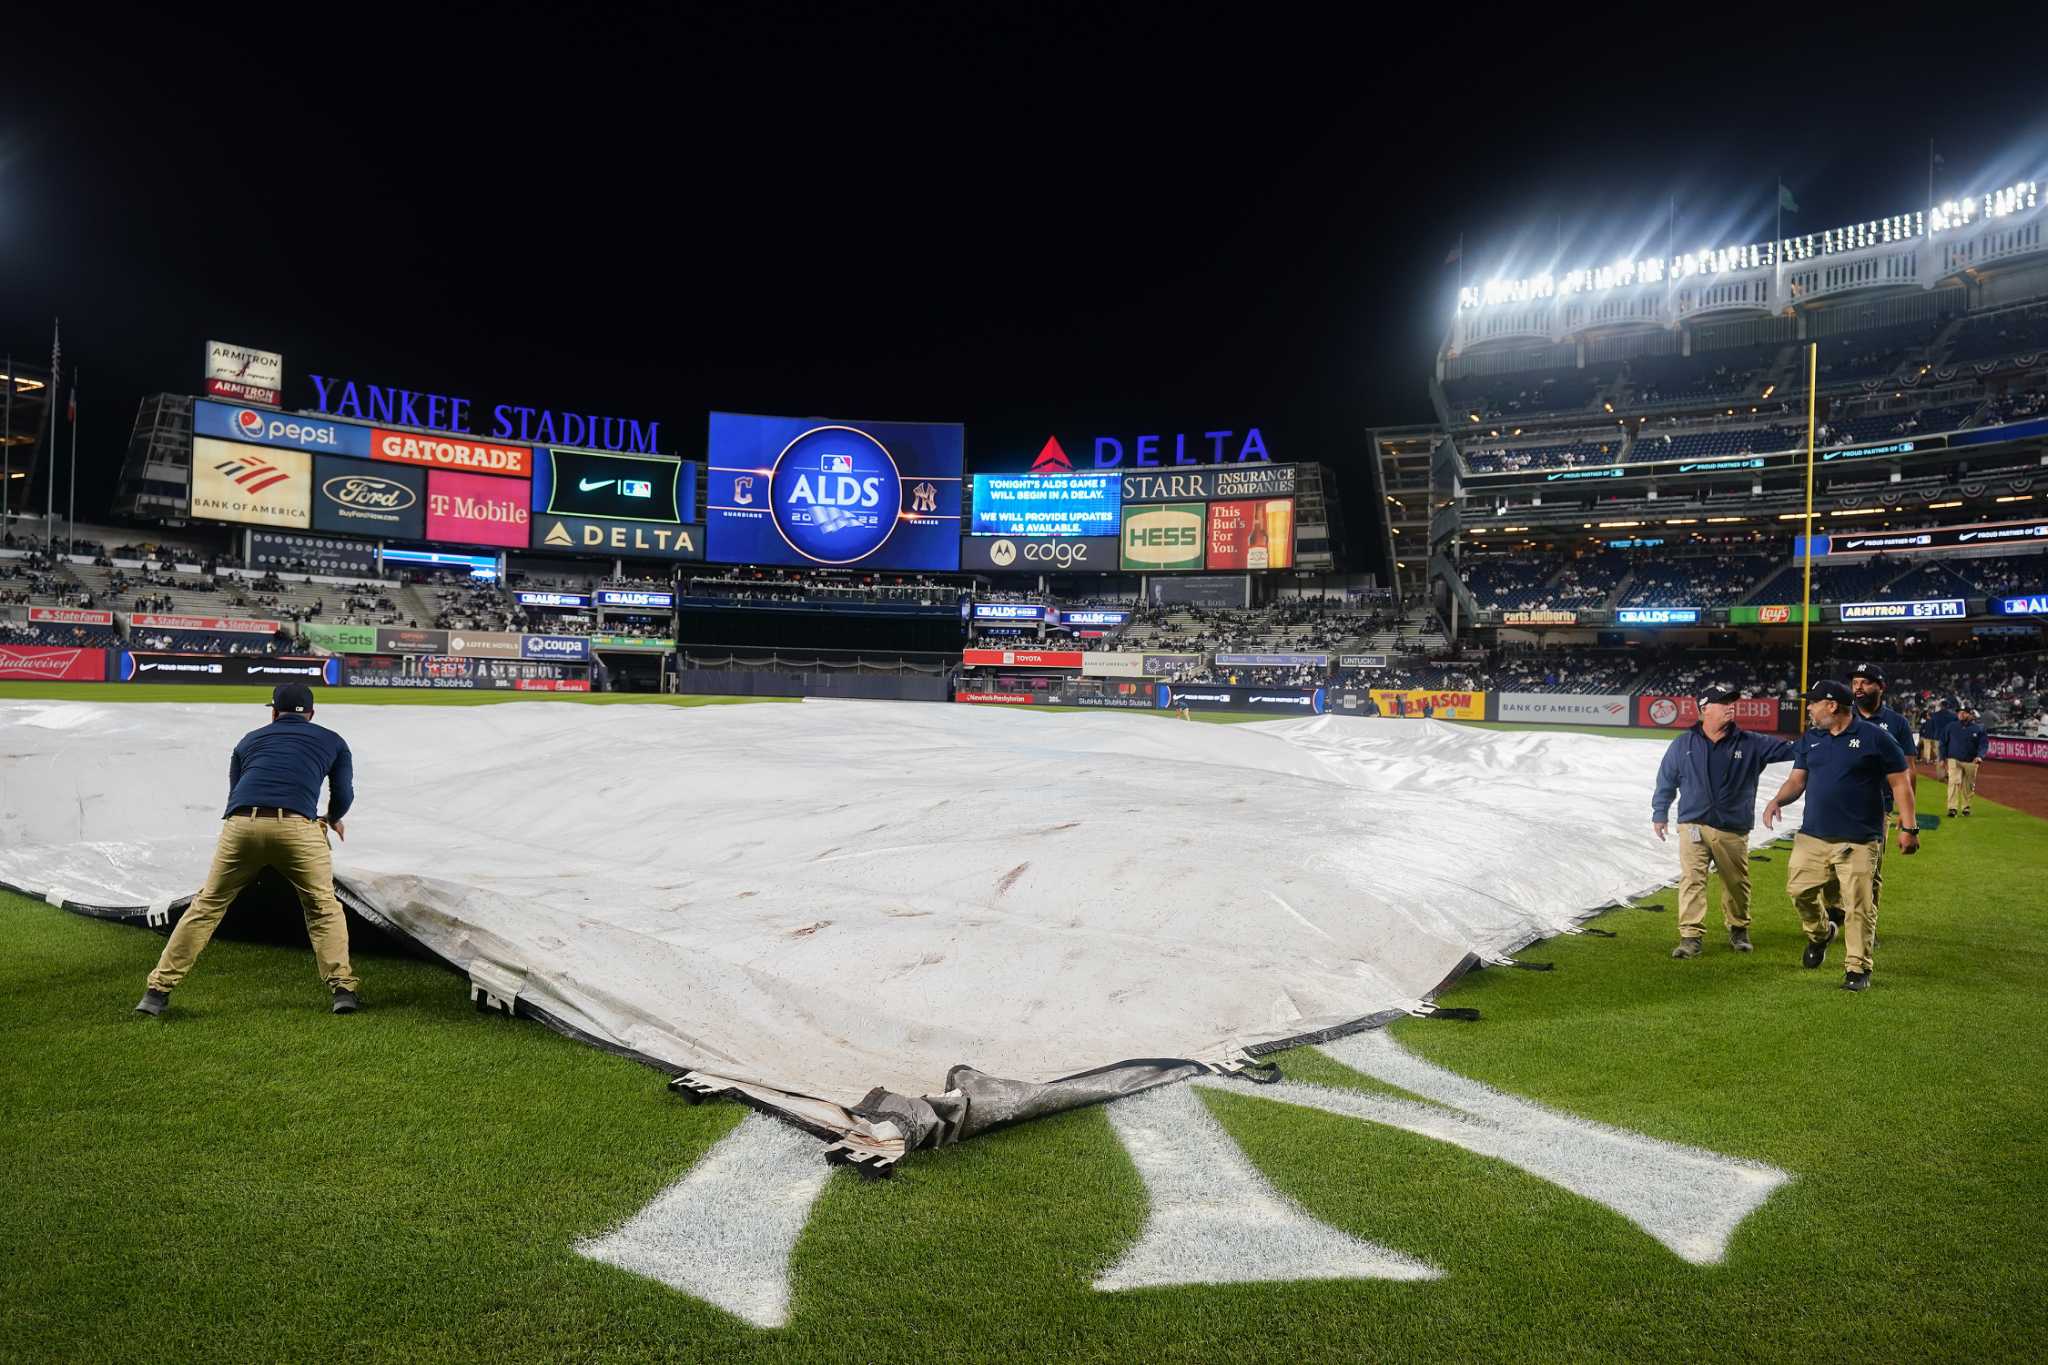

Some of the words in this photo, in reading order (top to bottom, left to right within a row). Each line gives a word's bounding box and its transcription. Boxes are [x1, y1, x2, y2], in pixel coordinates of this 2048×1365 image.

[212, 347, 279, 368] ARMITRON
[214, 381, 273, 402] ARMITRON
[309, 373, 472, 434] YANKEE
[492, 404, 661, 455] STADIUM
[269, 421, 336, 445] pepsi
[381, 436, 522, 471] GATORADE
[1094, 427, 1270, 469] DELTA
[1843, 449, 1863, 457] PROUD
[1864, 447, 1888, 456] PARTNER
[1218, 468, 1296, 484] INSURANCE
[988, 479, 1040, 489] TONIGHT'S
[1042, 479, 1068, 489] ALDS
[1069, 479, 1098, 489] GAME
[1123, 475, 1209, 499] STARR
[1217, 479, 1295, 496] COMPANIES
[339, 478, 400, 508] Ford
[787, 474, 880, 508] ALDS
[990, 490, 1015, 500] WILL
[1016, 490, 1047, 500] BEGIN
[1048, 490, 1060, 500] IN
[1060, 490, 1069, 500] A
[1070, 490, 1104, 500] DELAY.
[194, 498, 229, 511] BANK
[232, 502, 248, 513] OF
[252, 504, 307, 518] AMERICA
[1212, 505, 1241, 517] This
[722, 511, 763, 519] GUARDIANS
[980, 512, 997, 522] WE
[999, 512, 1023, 522] WILL
[1025, 512, 1068, 522] PROVIDE
[1069, 512, 1113, 522] UPDATES
[1010, 523, 1025, 533] AS
[1027, 523, 1083, 533] AVAILABLE.
[1212, 517, 1246, 530] Bud's
[583, 524, 695, 552] DELTA
[1129, 526, 1198, 547] HESS
[1212, 530, 1233, 542] For
[1998, 529, 2024, 537] PARTNER
[1023, 538, 1088, 569] edge
[1212, 542, 1238, 554] You.
[990, 606, 1017, 617] ALDS
[1504, 612, 1529, 621] Parts
[1530, 610, 1577, 622] Authority
[1845, 605, 1905, 617] ARMITRON
[1941, 602, 1957, 615] PM
[1082, 613, 1104, 622] ALDS
[1635, 611, 1669, 622] ALDS
[339, 632, 373, 646] Eats
[466, 641, 491, 649] LOTTE
[544, 640, 583, 653] coupa
[1016, 655, 1042, 663] TOYOTA
[350, 675, 389, 686] StubHub
[391, 676, 431, 687] StubHub
[433, 676, 473, 688] StubHub
[1502, 703, 1533, 714] BANK
[1534, 704, 1548, 713] OF
[1549, 704, 1600, 714] AMERICA
